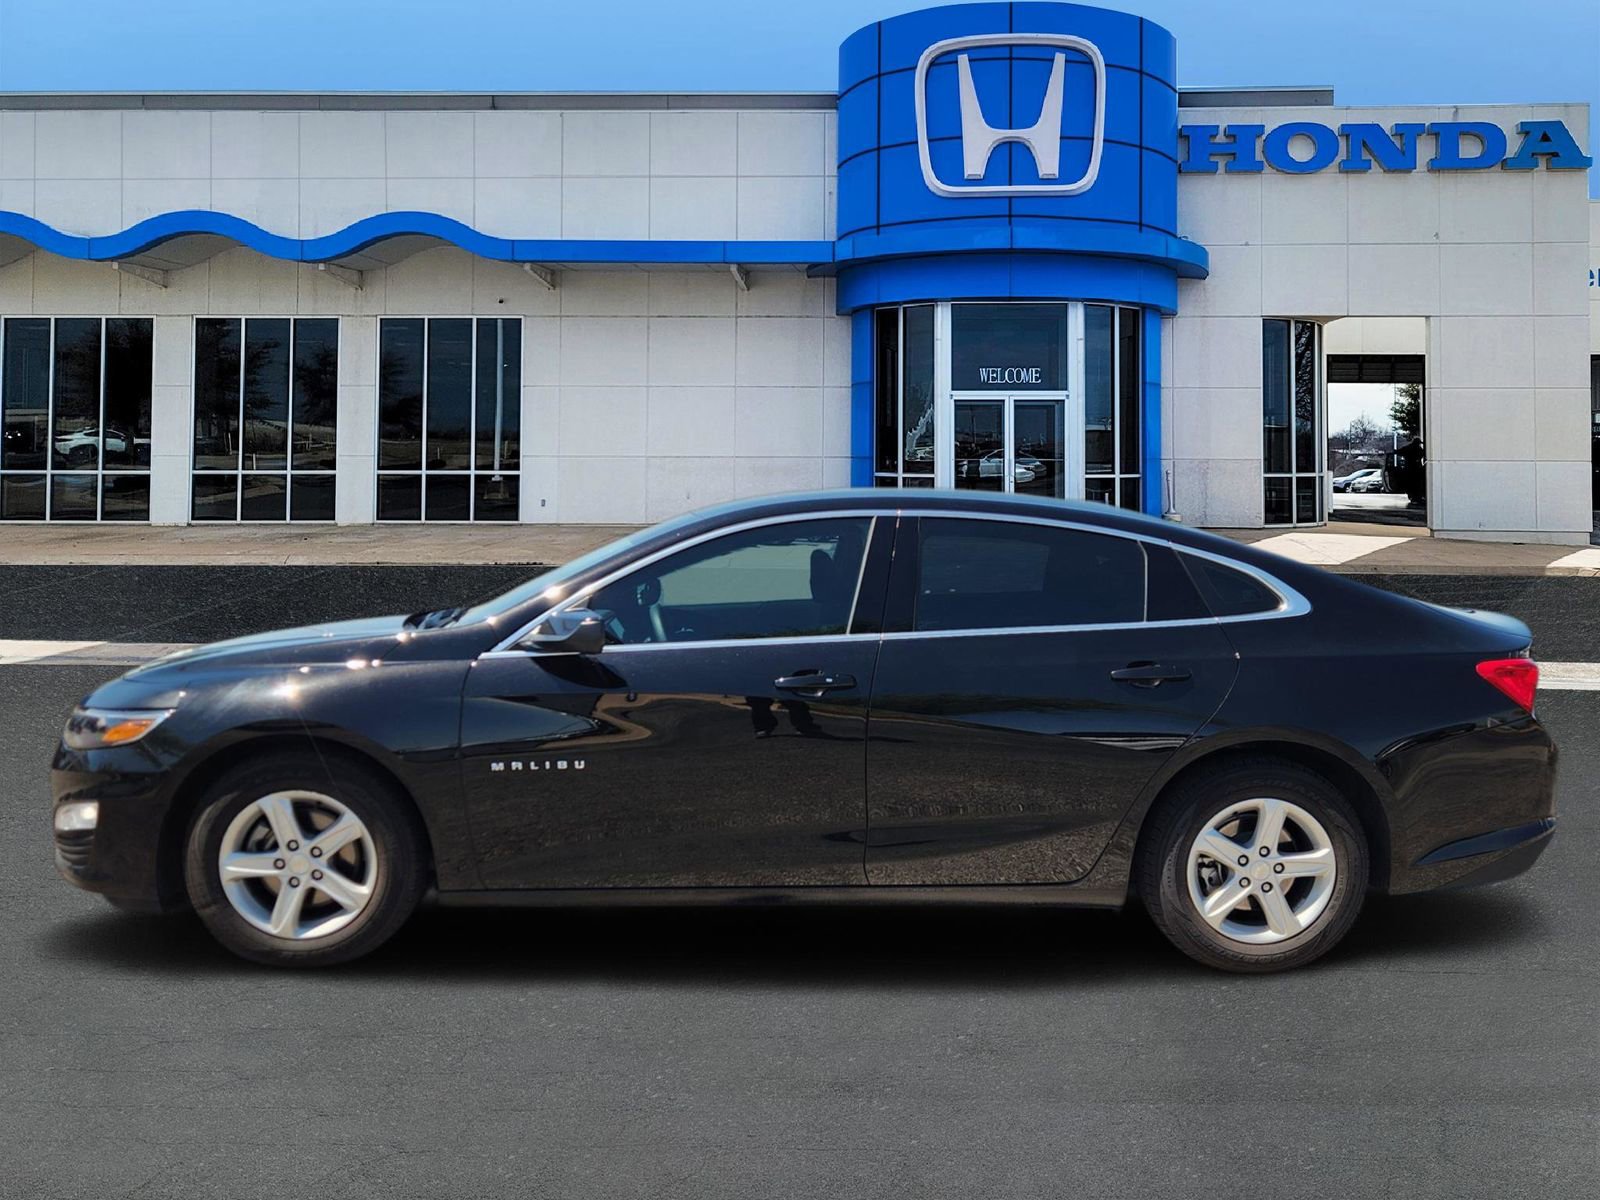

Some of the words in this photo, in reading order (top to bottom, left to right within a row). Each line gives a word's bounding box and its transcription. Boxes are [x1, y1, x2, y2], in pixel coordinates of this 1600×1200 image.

[1178, 119, 1593, 174] HONDA
[979, 367, 1042, 384] WELCOME
[490, 760, 586, 772] MALIBU
